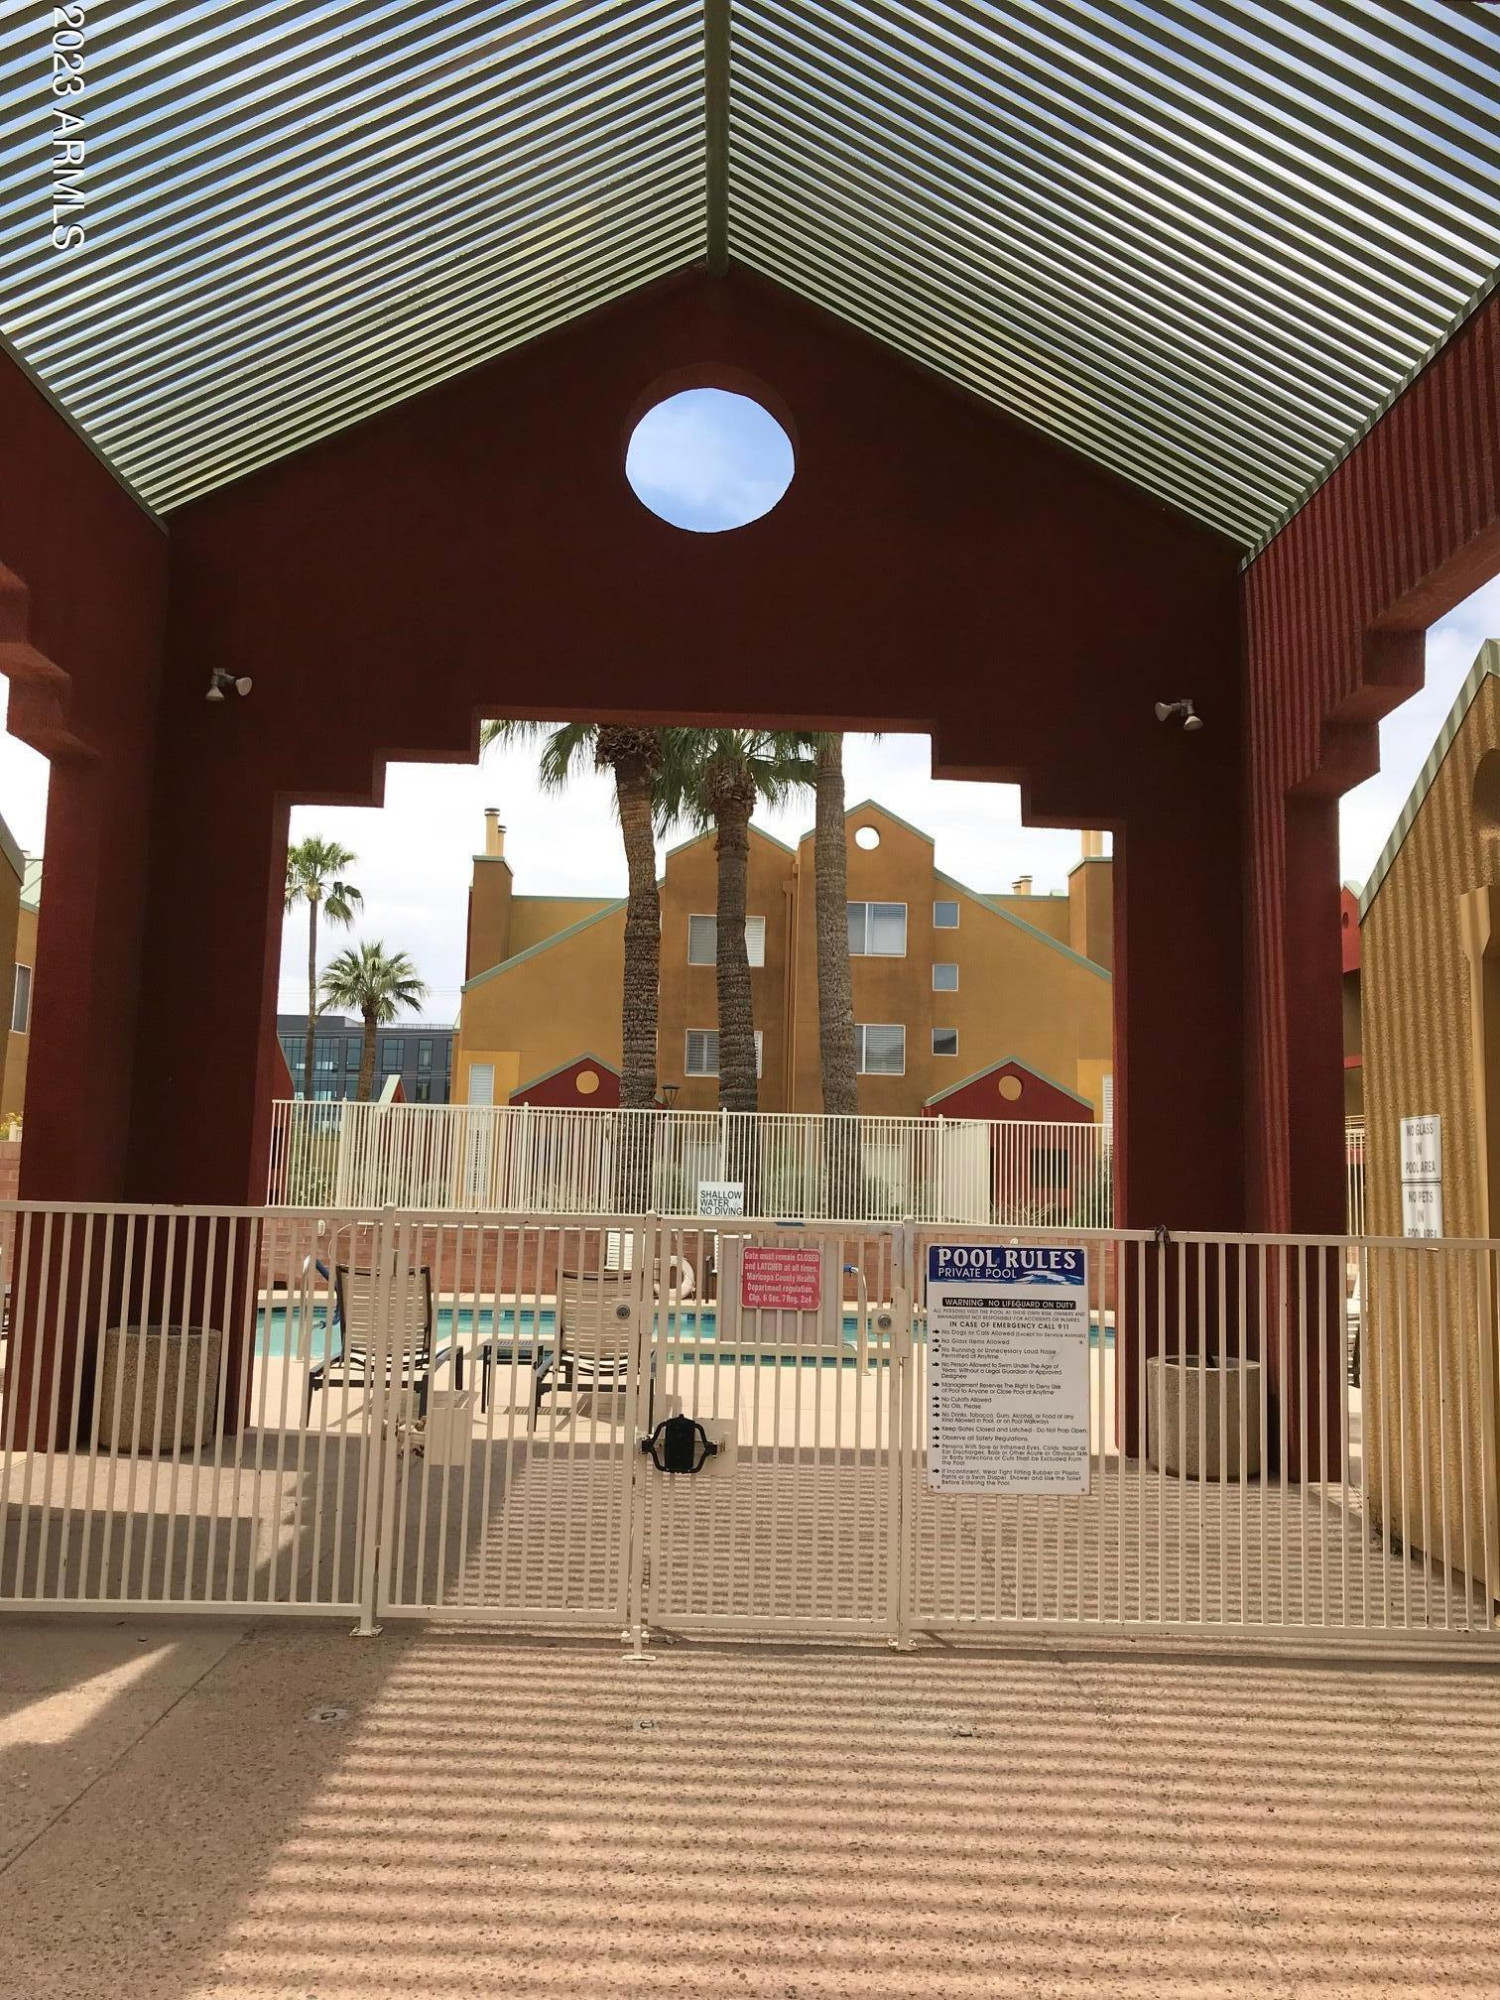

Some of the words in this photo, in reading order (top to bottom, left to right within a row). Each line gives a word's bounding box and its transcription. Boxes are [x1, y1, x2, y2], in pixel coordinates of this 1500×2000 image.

[1406, 1125, 1414, 1137] NO
[1416, 1123, 1433, 1135] GLASS
[1416, 1142, 1423, 1155] IN
[1406, 1162, 1419, 1174] POOL
[1420, 1161, 1436, 1173] AREA
[700, 1190, 742, 1199] SHALLOW
[1408, 1191, 1417, 1203] NO
[1418, 1191, 1433, 1203] PETS
[700, 1199, 729, 1207] WATER
[700, 1206, 712, 1215] NO
[714, 1207, 743, 1215] DIVING
[1417, 1210, 1424, 1222] IN
[744, 1252, 759, 1260] Gate
[796, 1254, 819, 1262] CLOSED
[938, 1249, 998, 1268] POOL
[1005, 1250, 1076, 1269] RULES
[745, 1262, 756, 1270] and
[757, 1262, 783, 1271] LATCHED
[746, 1272, 774, 1283] Maricopa
[775, 1273, 795, 1283] County
[796, 1274, 816, 1283] Health
[938, 1268, 981, 1278] PRIVATE
[986, 1269, 1017, 1279] POOL
[747, 1282, 781, 1292] Department
[944, 1298, 984, 1306] WARNING
